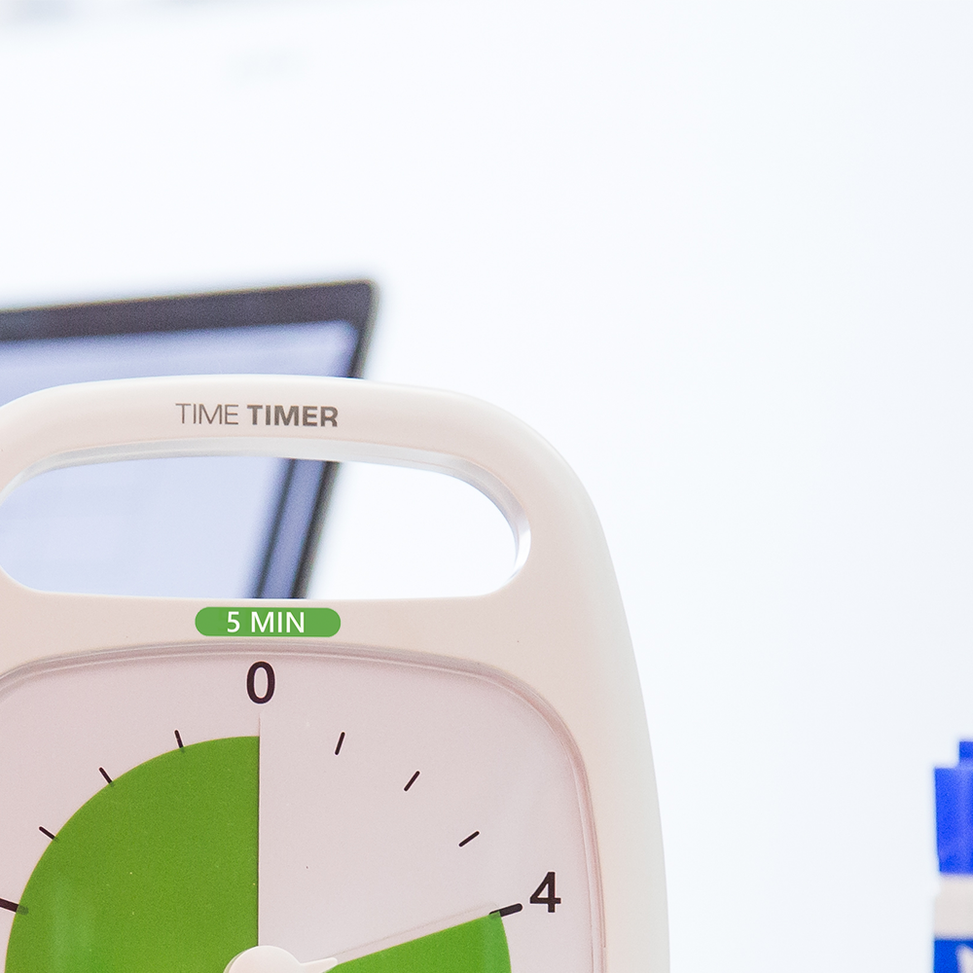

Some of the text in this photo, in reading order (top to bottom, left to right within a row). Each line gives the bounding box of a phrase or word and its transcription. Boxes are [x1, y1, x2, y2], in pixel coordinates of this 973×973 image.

[175, 403, 339, 427] TIME TIMER
[227, 611, 305, 633] 5 MIN
[246, 661, 276, 705] 0
[529, 871, 562, 913] 4
